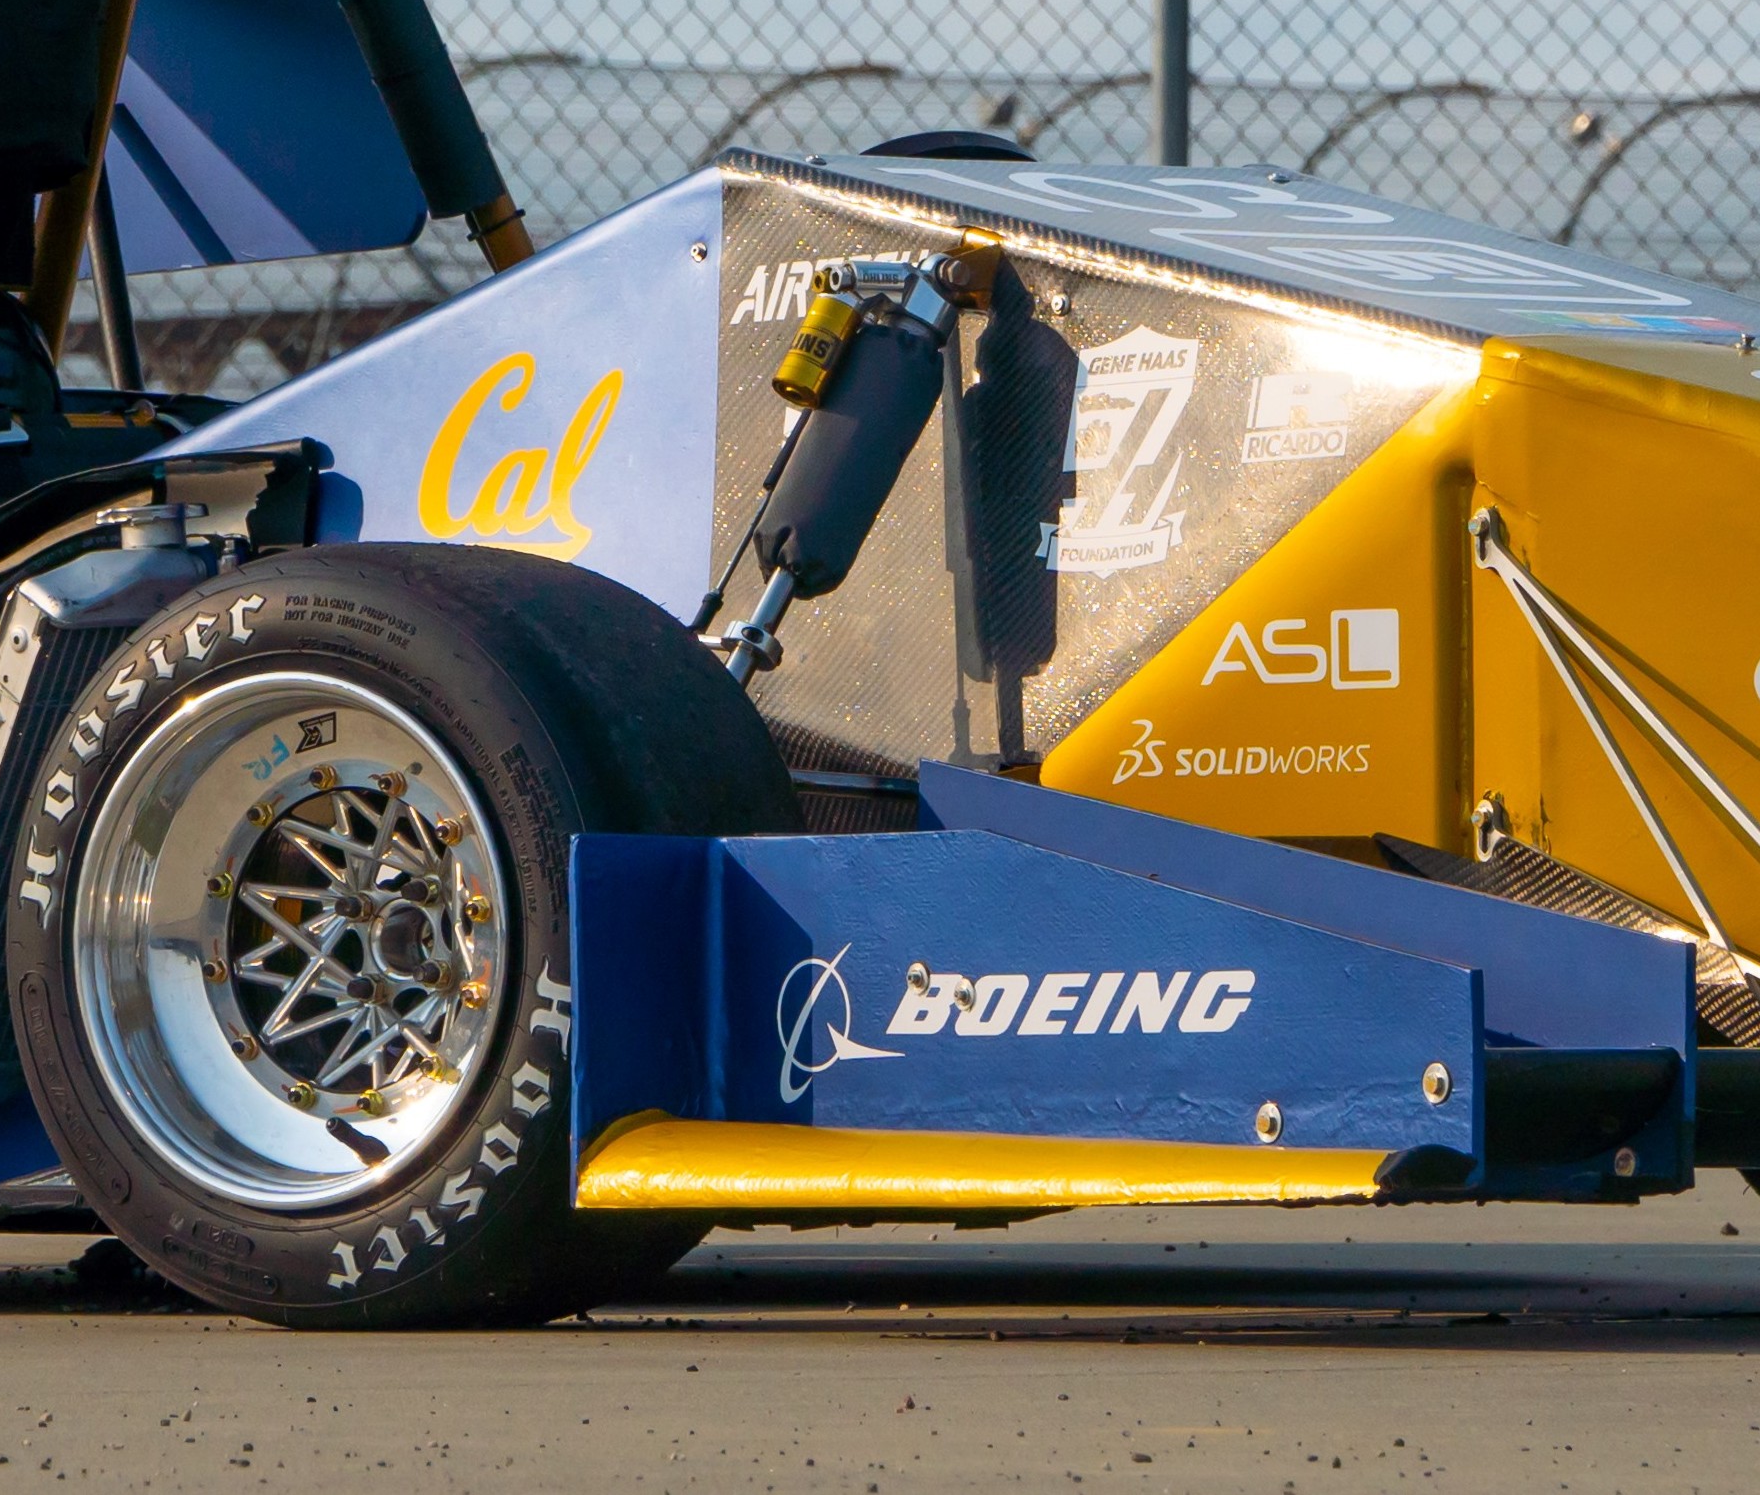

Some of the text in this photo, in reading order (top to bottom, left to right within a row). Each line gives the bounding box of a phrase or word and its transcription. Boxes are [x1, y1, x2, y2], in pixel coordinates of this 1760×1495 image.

[1089, 349, 1188, 375] GENE HAAS
[417, 351, 625, 561] Cal
[1247, 429, 1344, 459] RICARDO
[1059, 540, 1154, 563] FOUNDATION
[285, 595, 308, 607] FOR
[310, 609, 334, 623] FOR
[1201, 609, 1399, 689] ASL
[18, 592, 267, 929] Hoosier
[1175, 744, 1371, 777] SOLIDWORKS
[886, 969, 1256, 1036] BOEING
[327, 955, 571, 1290] Hoosier
